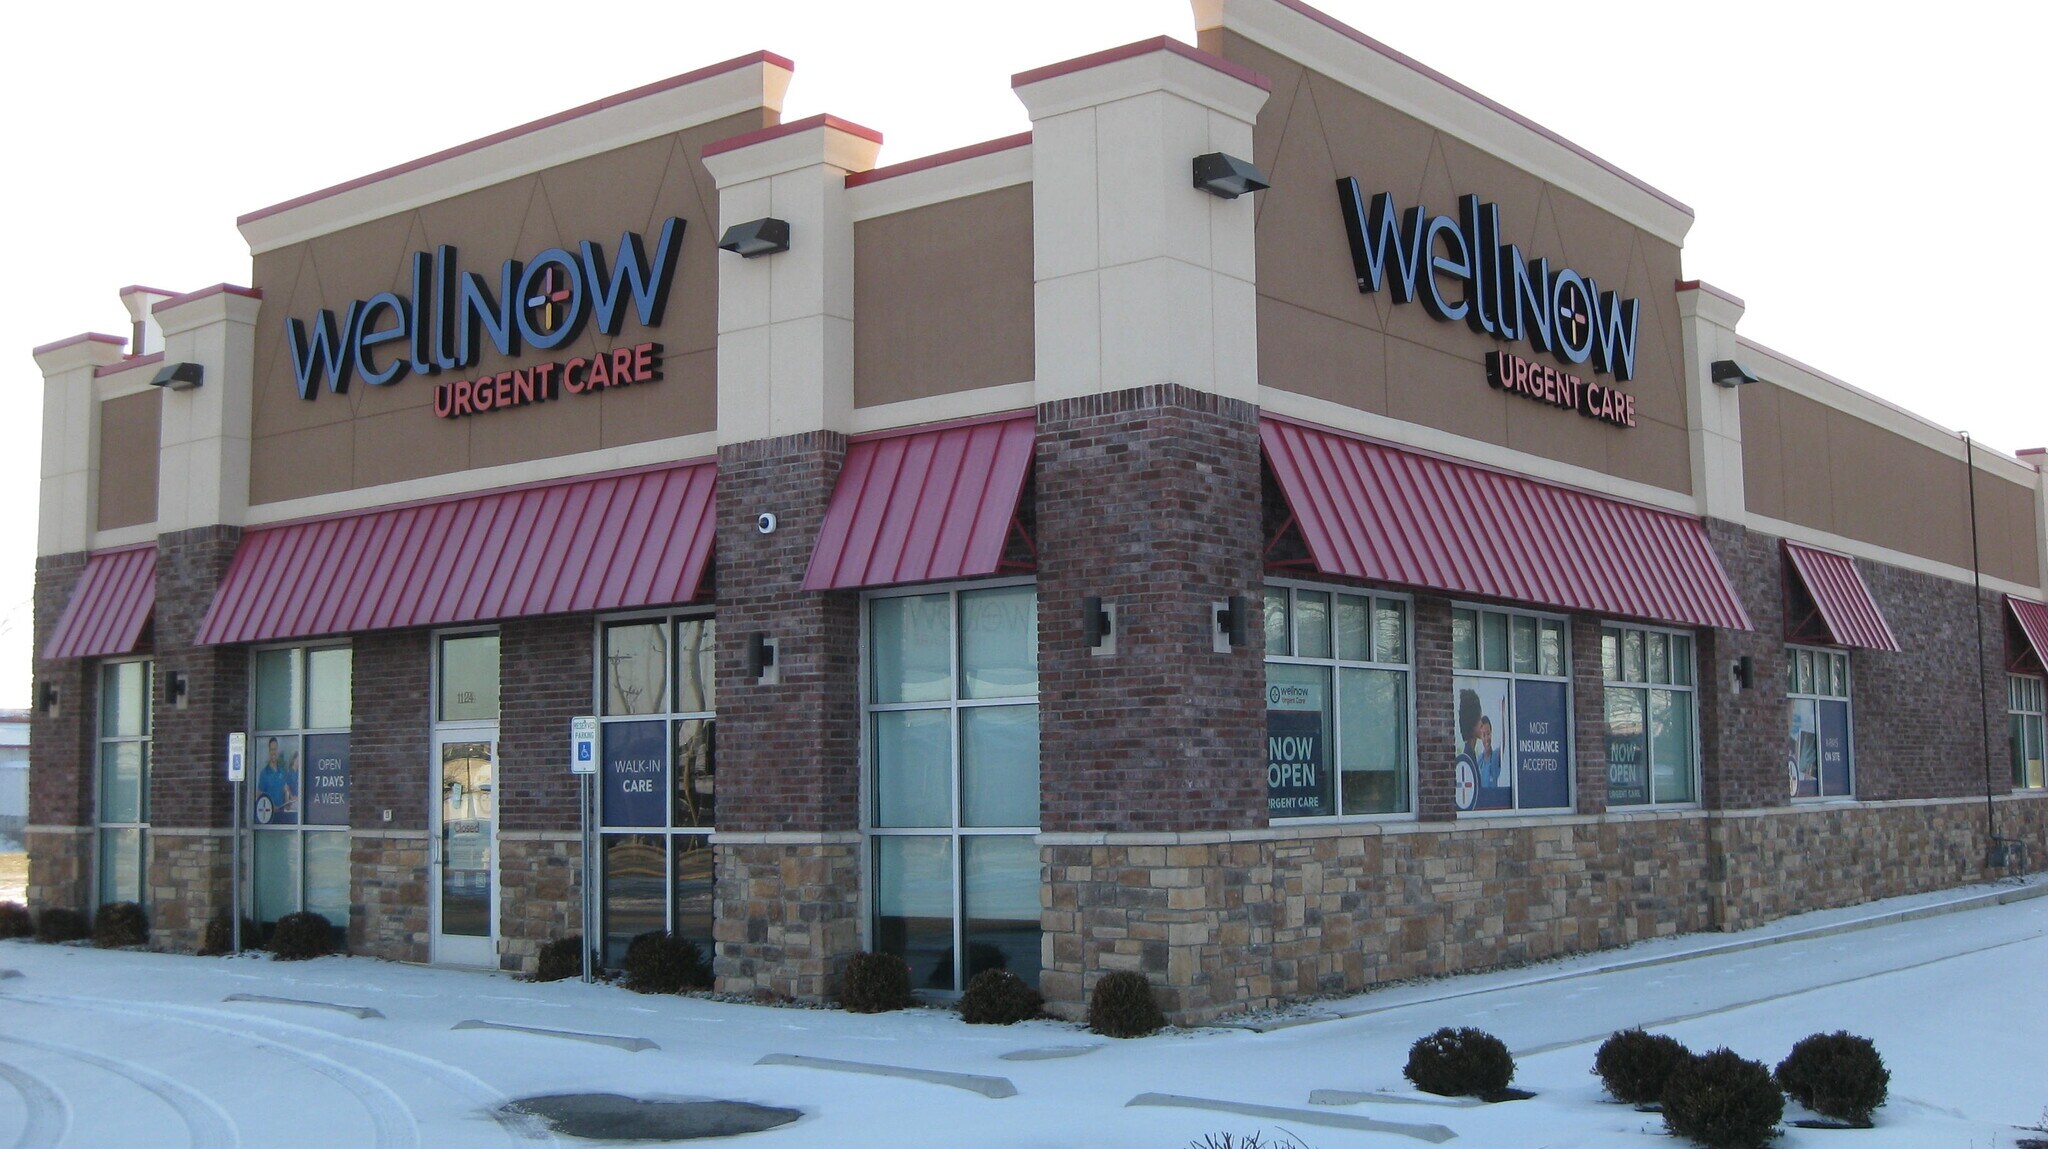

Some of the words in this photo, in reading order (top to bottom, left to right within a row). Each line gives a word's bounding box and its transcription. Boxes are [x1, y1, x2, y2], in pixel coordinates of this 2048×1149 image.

[433, 362, 556, 419] URGENT
[563, 341, 662, 395] CARE
[1487, 350, 1583, 410] URGENT
[1584, 382, 1637, 428] CARE
[1529, 721, 1549, 735] MOST
[1269, 736, 1313, 760] NOW
[1519, 739, 1559, 753] INSURANCE
[1611, 743, 1636, 762] NOW
[318, 758, 342, 770] OPEN
[615, 760, 661, 773] WALK-IN
[1522, 758, 1558, 771] ACCEPTED
[1267, 762, 1316, 788] OPEN
[1610, 763, 1636, 783] OPEN
[315, 775, 321, 787] 7
[322, 775, 345, 787] DAYS
[623, 779, 653, 792] CARE
[313, 793, 321, 804] A
[321, 792, 345, 805] WEEK
[1298, 796, 1319, 808] CARE
[453, 822, 480, 833] Closed
